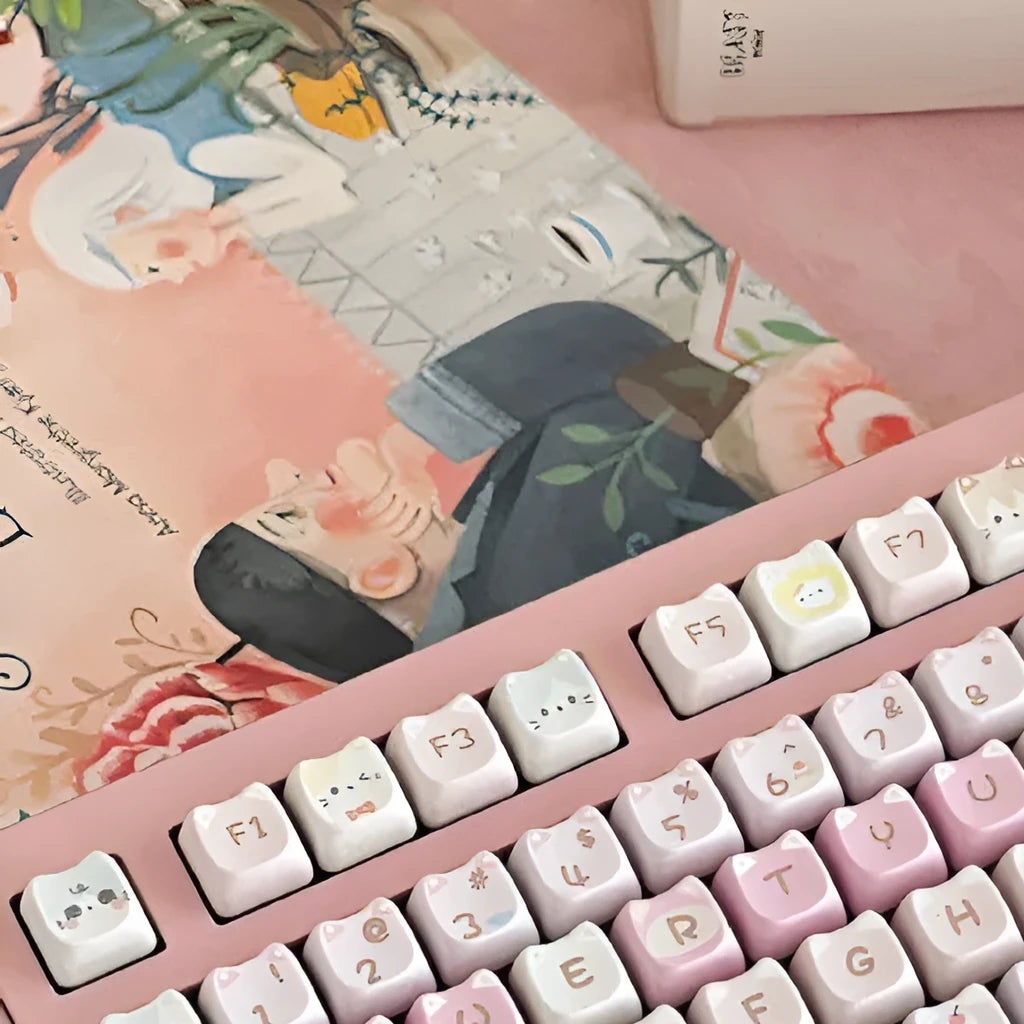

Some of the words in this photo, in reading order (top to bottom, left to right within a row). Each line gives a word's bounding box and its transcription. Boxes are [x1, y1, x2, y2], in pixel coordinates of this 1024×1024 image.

[883, 529, 925, 559] F7
[683, 614, 726, 646] F5
[882, 695, 904, 720] &
[965, 684, 989, 706] 8
[428, 727, 476, 759] F3
[863, 728, 886, 751] 7
[766, 772, 790, 797] 6
[966, 773, 998, 802] U
[225, 815, 268, 846] F1
[660, 814, 686, 842] 5
[869, 820, 895, 850] Y
[560, 864, 591, 887] 4
[762, 864, 793, 896] T
[362, 917, 390, 944] @
[452, 912, 482, 940] 3
[666, 914, 698, 946] R
[944, 898, 981, 936] H
[268, 963, 285, 984] !
[355, 958, 382, 985] 2
[559, 956, 595, 990] E
[845, 945, 875, 977] G
